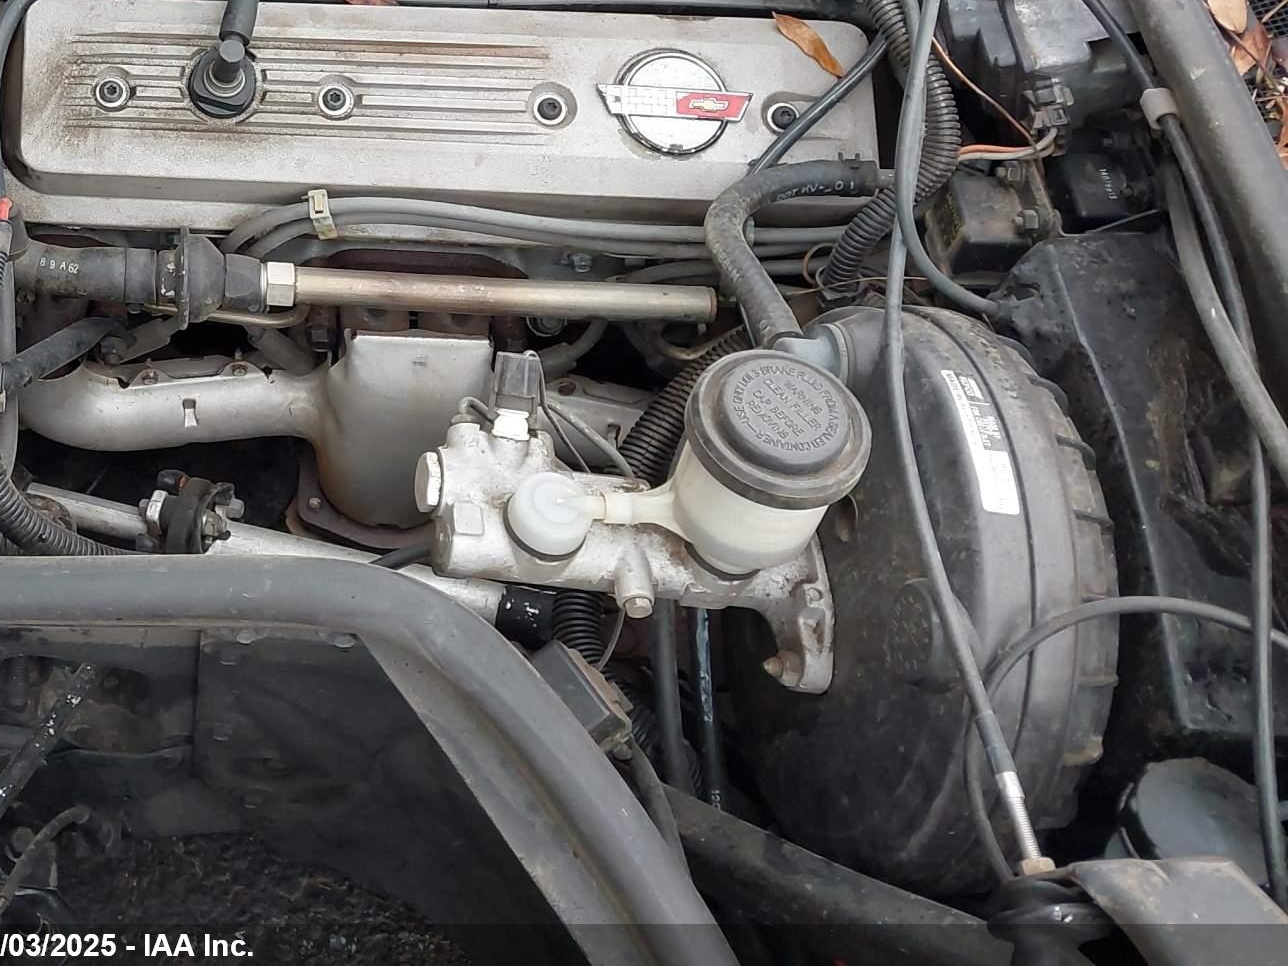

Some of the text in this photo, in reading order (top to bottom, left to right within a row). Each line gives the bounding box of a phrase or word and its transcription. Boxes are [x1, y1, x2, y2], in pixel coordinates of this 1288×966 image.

[759, 365, 795, 378] BRAKE
[763, 378, 822, 431] CLEAN FILLER
[769, 407, 805, 437] BEFORE
